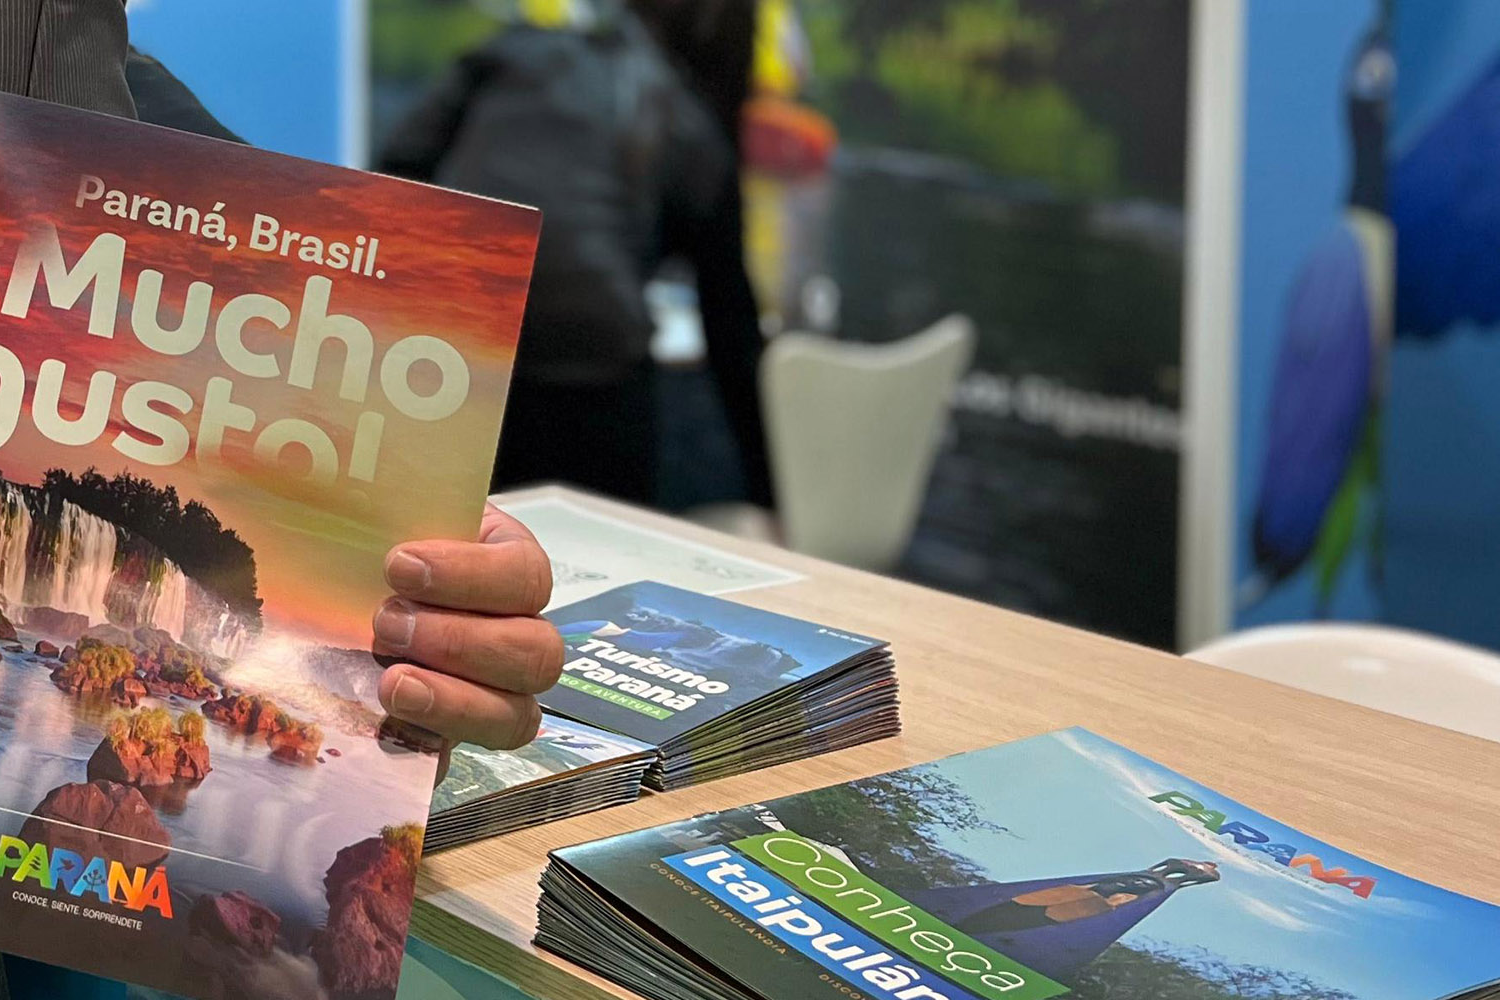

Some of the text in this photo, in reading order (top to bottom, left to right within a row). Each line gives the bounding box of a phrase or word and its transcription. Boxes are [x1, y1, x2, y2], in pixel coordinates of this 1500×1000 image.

[75, 173, 387, 279] Paraná, Brasil.
[562, 656, 706, 711] Paraná
[577, 638, 730, 694] Turismo
[594, 687, 661, 717] AVENTURA
[650, 863, 700, 896] CONOCE
[82, 907, 143, 931] SORPRENDETE
[762, 837, 1026, 992] Conheça
